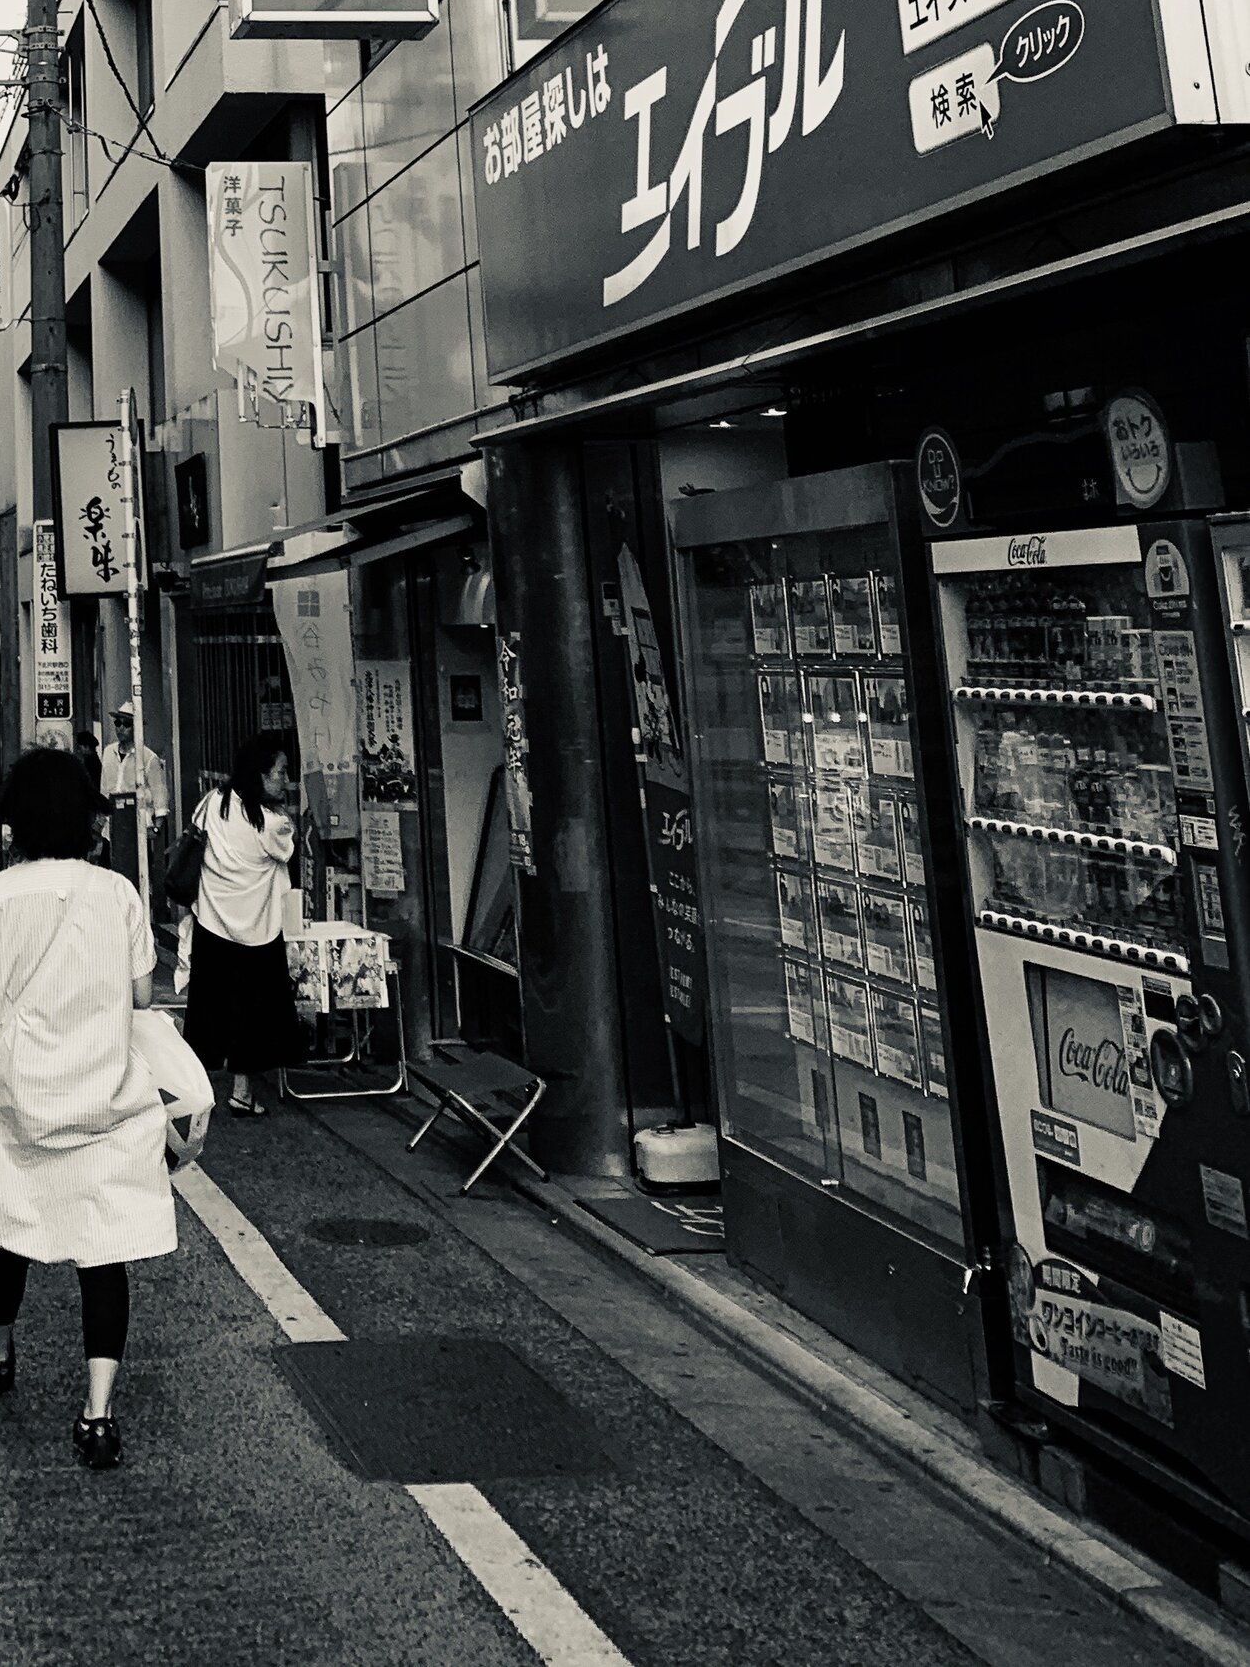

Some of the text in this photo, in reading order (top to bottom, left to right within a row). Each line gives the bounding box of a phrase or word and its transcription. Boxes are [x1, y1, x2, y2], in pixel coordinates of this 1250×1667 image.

[1014, 12, 1071, 70] クリック
[483, 43, 613, 185] お部屋探しは
[929, 71, 979, 129] 検索
[224, 175, 243, 237] 洋菓子
[1008, 536, 1047, 566] Coca-Cola
[40, 562, 58, 655] たねいち歯科
[1059, 1027, 1129, 1098] Coca-Cola
